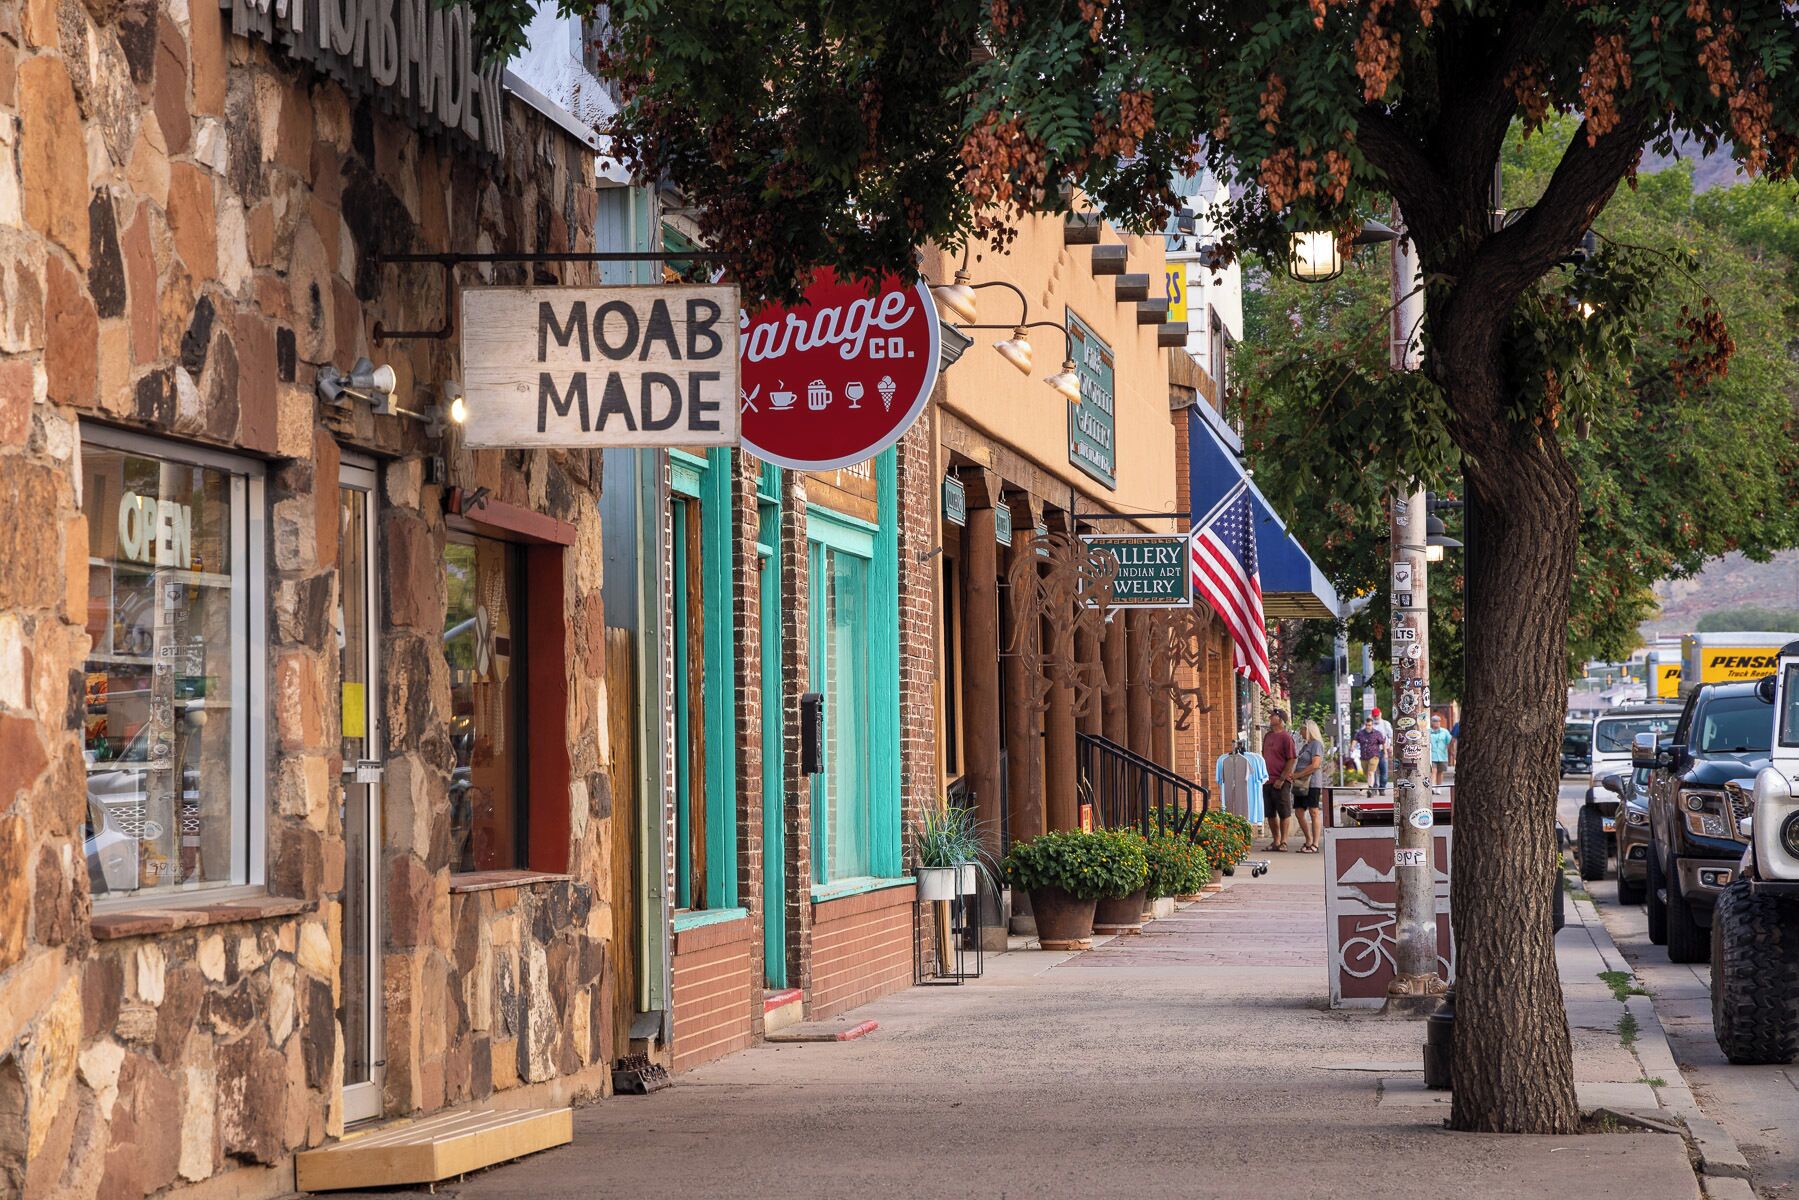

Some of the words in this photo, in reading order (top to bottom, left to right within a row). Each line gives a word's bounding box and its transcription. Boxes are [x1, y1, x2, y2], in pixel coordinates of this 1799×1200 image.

[537, 298, 723, 362] MOAB
[869, 337, 915, 359] CO.
[537, 370, 721, 432] MADE
[118, 491, 192, 569] OPEN
[1089, 547, 1181, 565] ALLERY
[1119, 567, 1155, 577] INDIAN
[1160, 567, 1181, 577] ART
[1111, 580, 1175, 593] WELRY
[1710, 656, 1779, 668] PENSK
